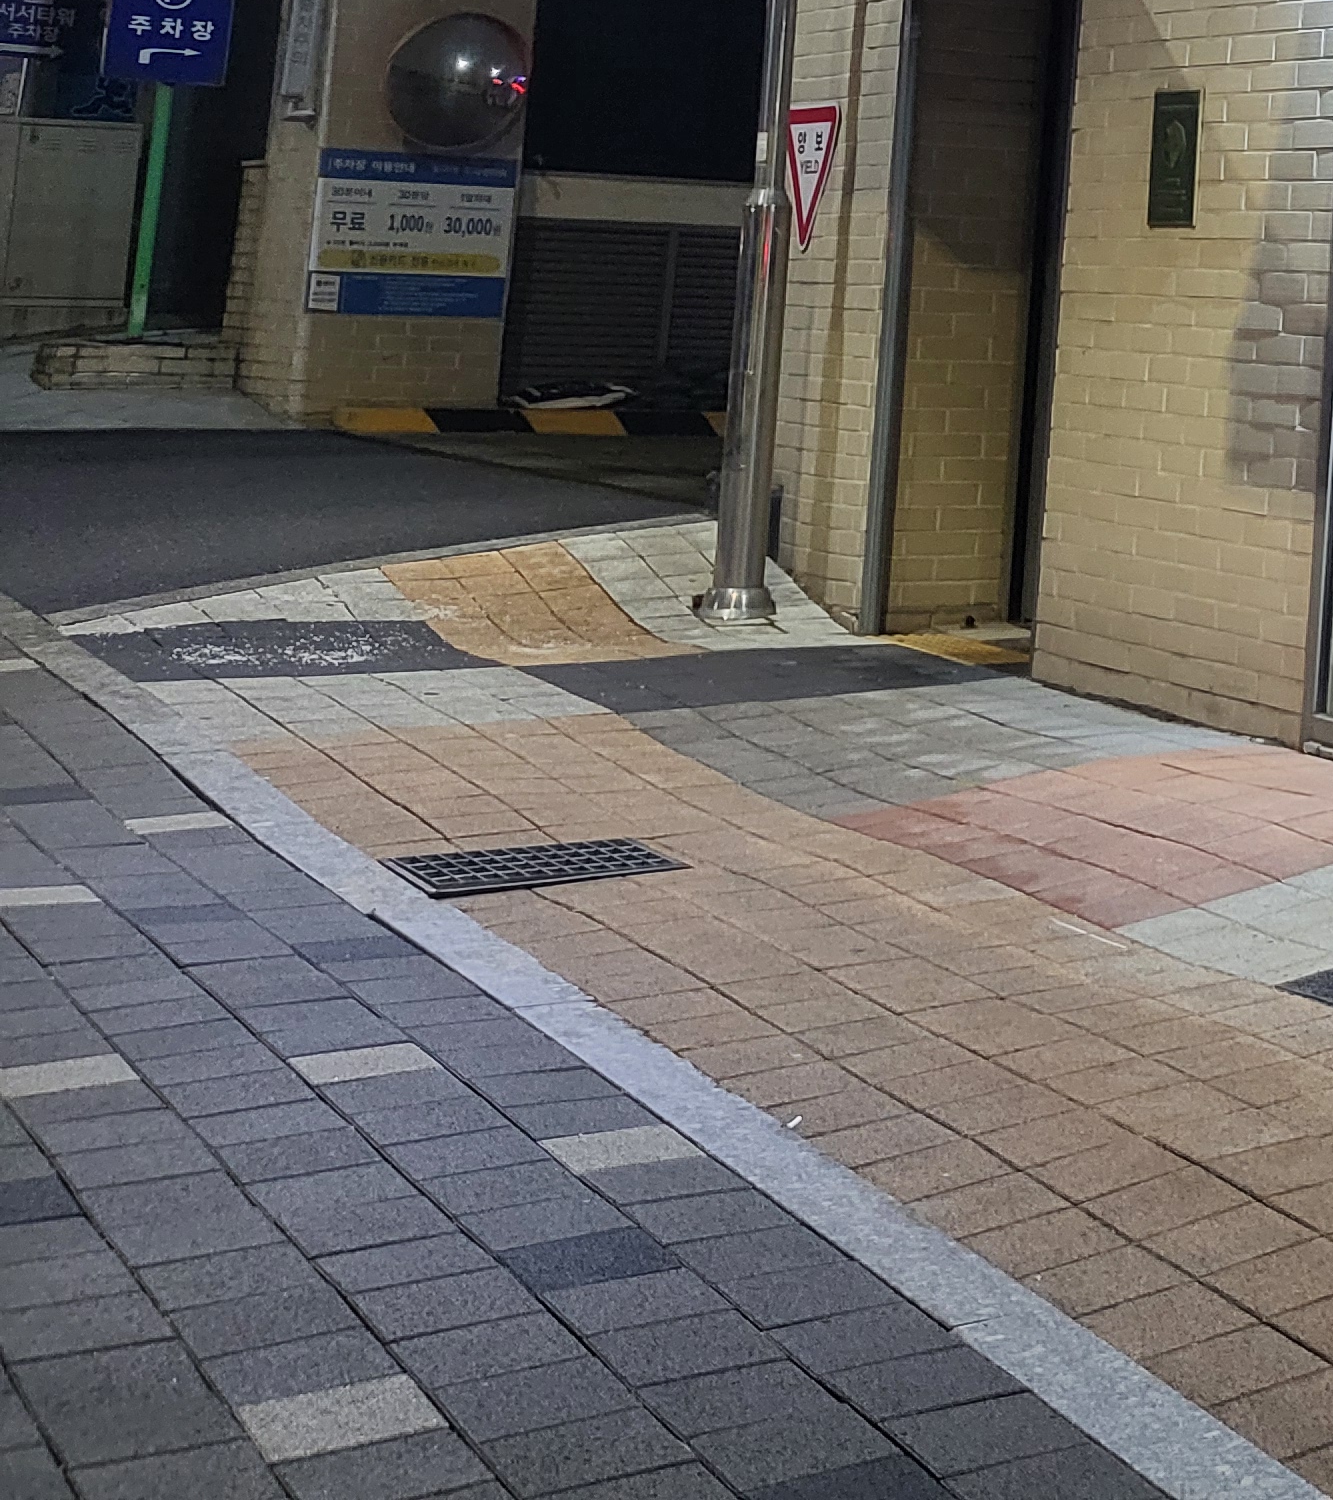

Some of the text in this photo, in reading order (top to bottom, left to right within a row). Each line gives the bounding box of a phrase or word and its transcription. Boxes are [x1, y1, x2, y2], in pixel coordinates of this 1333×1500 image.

[8, 23, 60, 43] 주차장
[333, 157, 368, 172] 주차장
[330, 210, 366, 233] 무료
